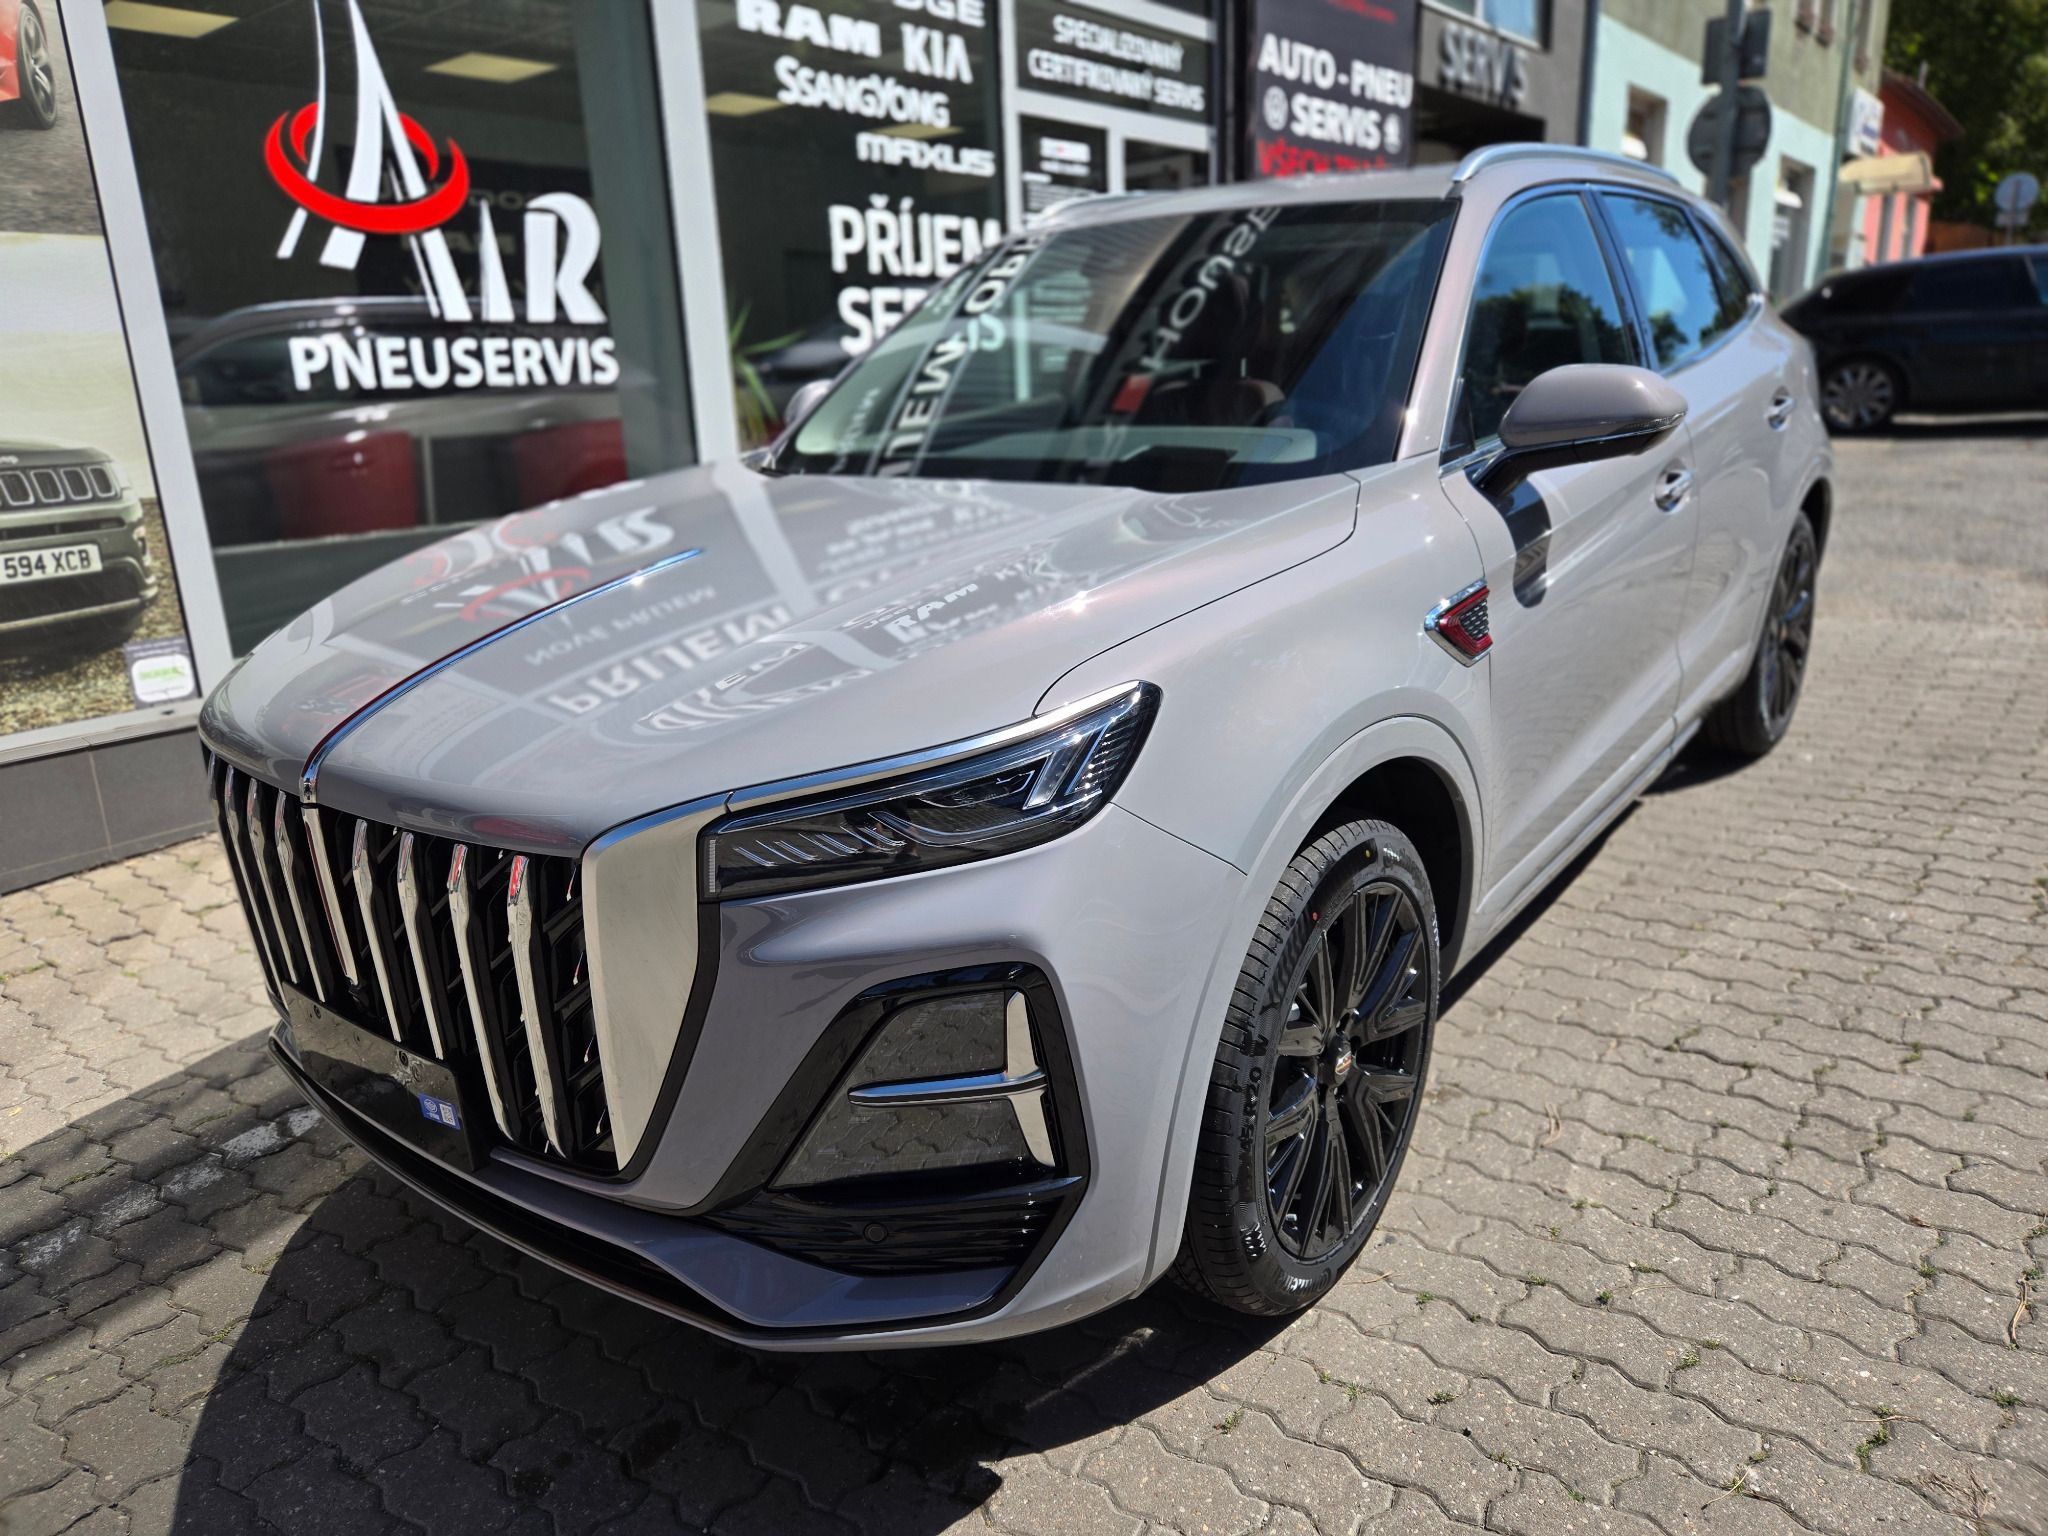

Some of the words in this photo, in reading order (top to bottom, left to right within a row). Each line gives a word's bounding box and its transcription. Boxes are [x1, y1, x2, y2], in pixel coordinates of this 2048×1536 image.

[736, 0, 882, 58] RAM
[901, 22, 974, 84] KIA
[1257, 33, 1336, 89] AUTO
[1351, 59, 1414, 109] PNEU
[1290, 92, 1382, 150] SERVIS
[856, 131, 996, 178] MAXUS
[828, 193, 1002, 278] PŘÍJEM
[288, 335, 620, 391] PNEUSERVIS
[4, 553, 47, 579] 594
[51, 548, 92, 573] XCB
